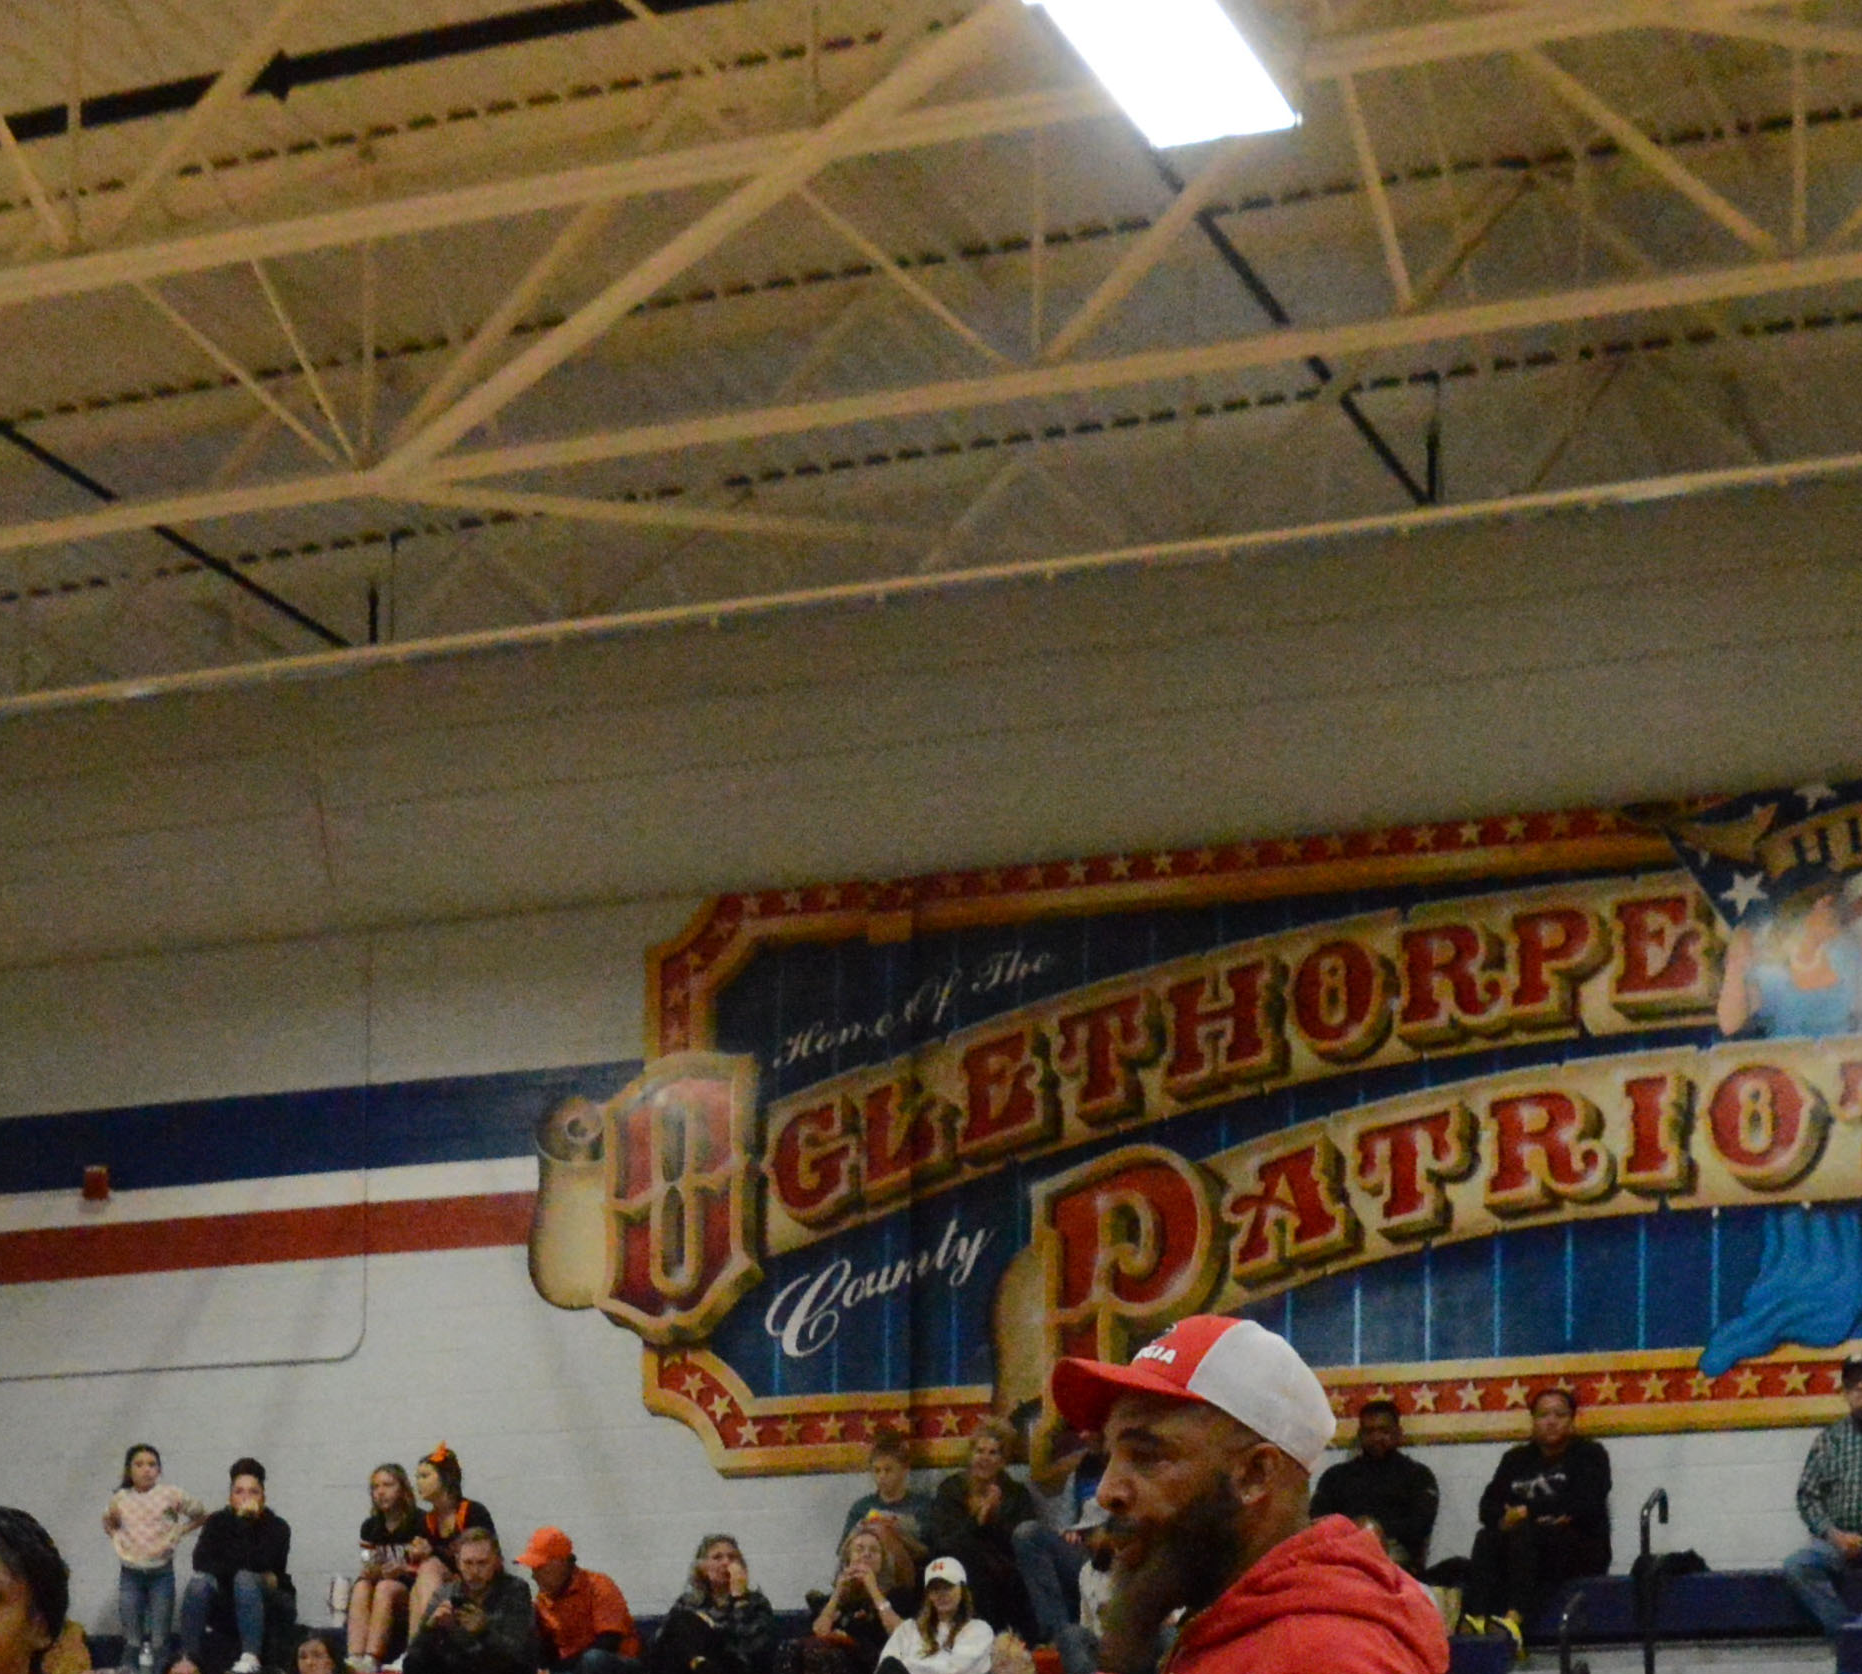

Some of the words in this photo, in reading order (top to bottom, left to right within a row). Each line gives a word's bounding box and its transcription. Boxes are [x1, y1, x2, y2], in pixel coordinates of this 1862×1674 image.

[772, 1012, 895, 1069] Home
[904, 968, 963, 1025] Of
[971, 949, 1051, 992] The
[765, 1217, 996, 1359] County
